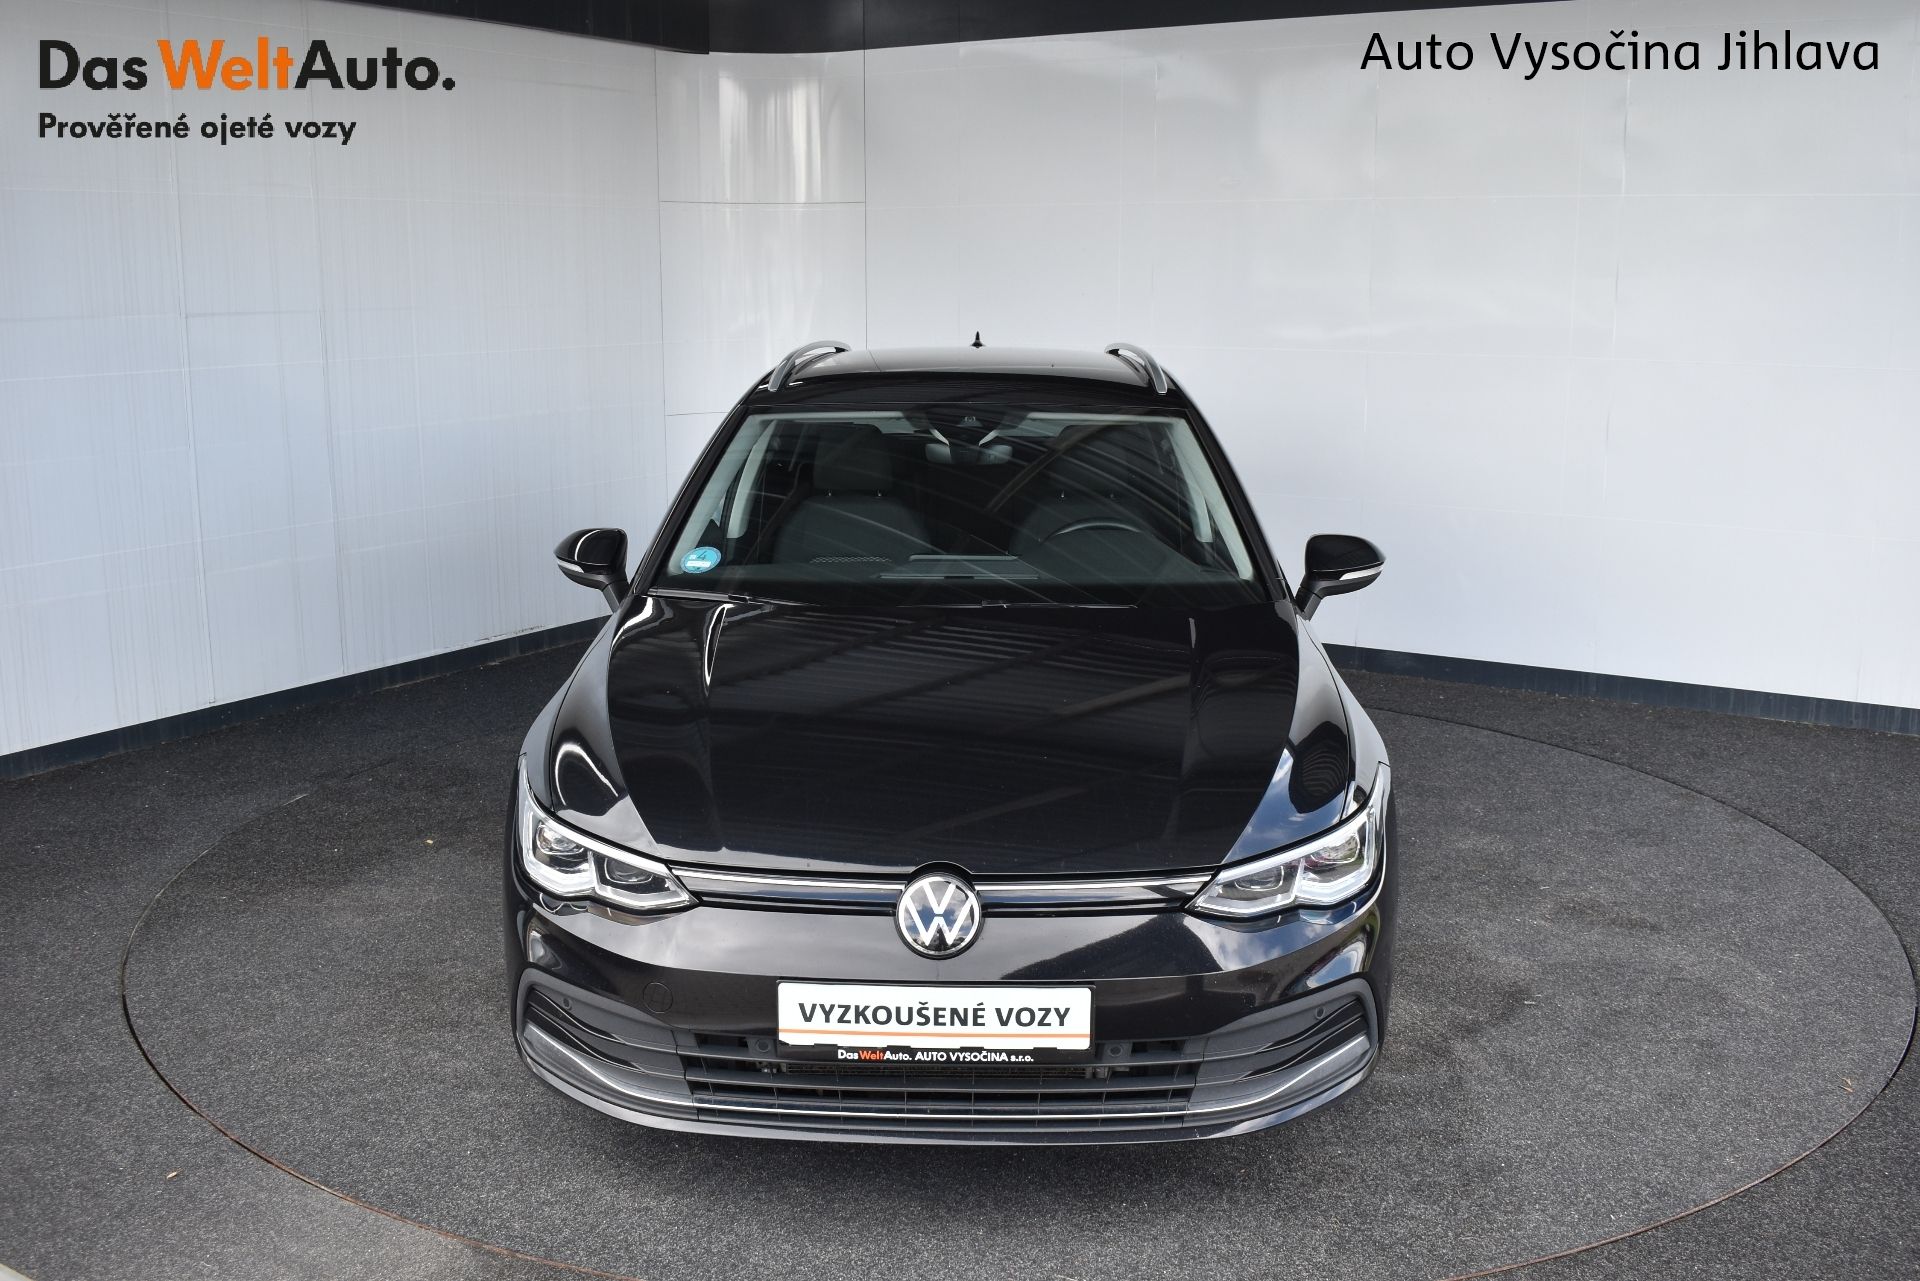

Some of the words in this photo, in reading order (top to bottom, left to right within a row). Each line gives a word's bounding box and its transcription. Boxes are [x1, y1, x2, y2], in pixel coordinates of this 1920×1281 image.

[798, 1001, 987, 1027] VYZKOUŠENÉ
[994, 1007, 1071, 1027] VOZY
[914, 1051, 947, 1062] AUTO
[949, 1050, 1009, 1062] VYSOČINA
[1010, 1053, 1034, 1062] s.r.o.
